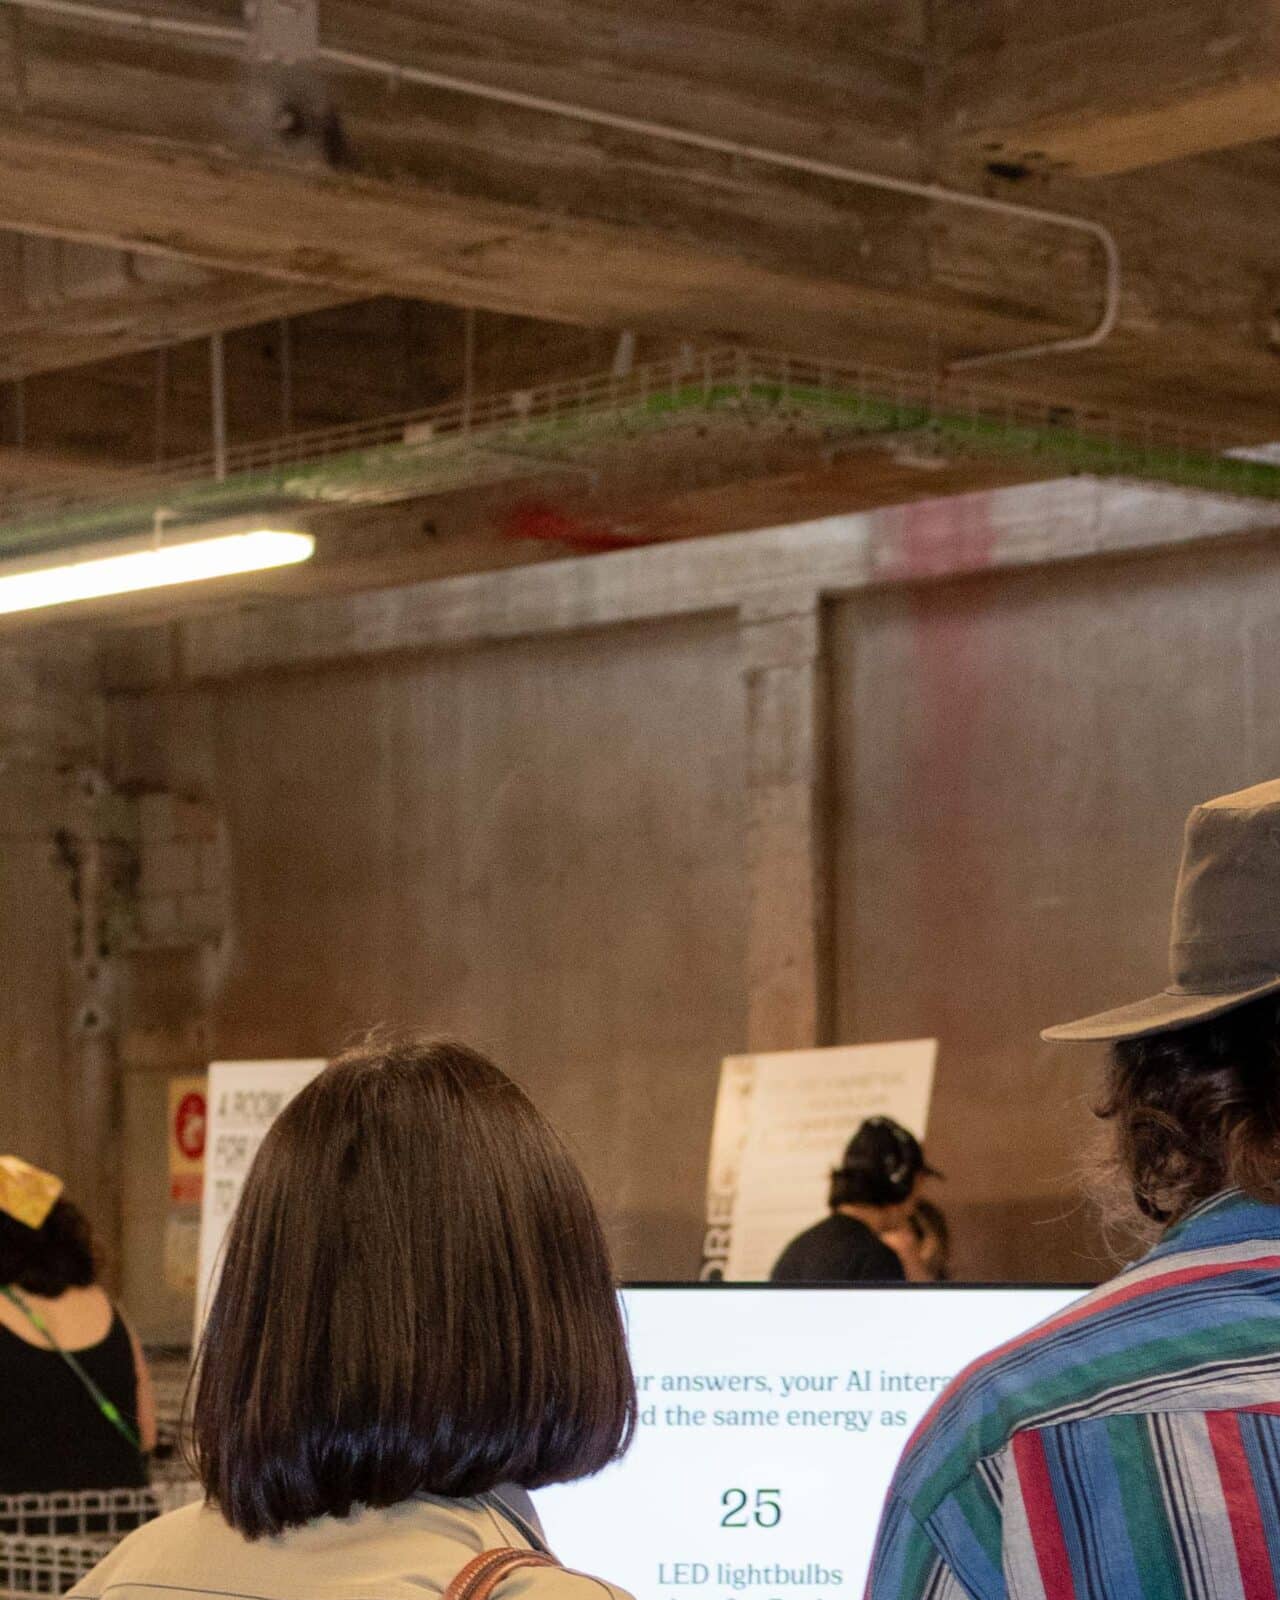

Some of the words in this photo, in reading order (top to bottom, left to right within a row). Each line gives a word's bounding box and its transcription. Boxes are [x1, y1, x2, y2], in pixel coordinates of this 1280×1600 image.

[661, 1375, 772, 1393] answers,
[780, 1374, 838, 1397] your
[846, 1370, 871, 1391] AI
[665, 1405, 706, 1426] the
[713, 1409, 779, 1426] same
[786, 1409, 873, 1432] energy
[880, 1409, 907, 1426] as
[719, 1488, 782, 1528] 25
[657, 1563, 709, 1585] LED
[717, 1563, 843, 1590] lightbulbs
